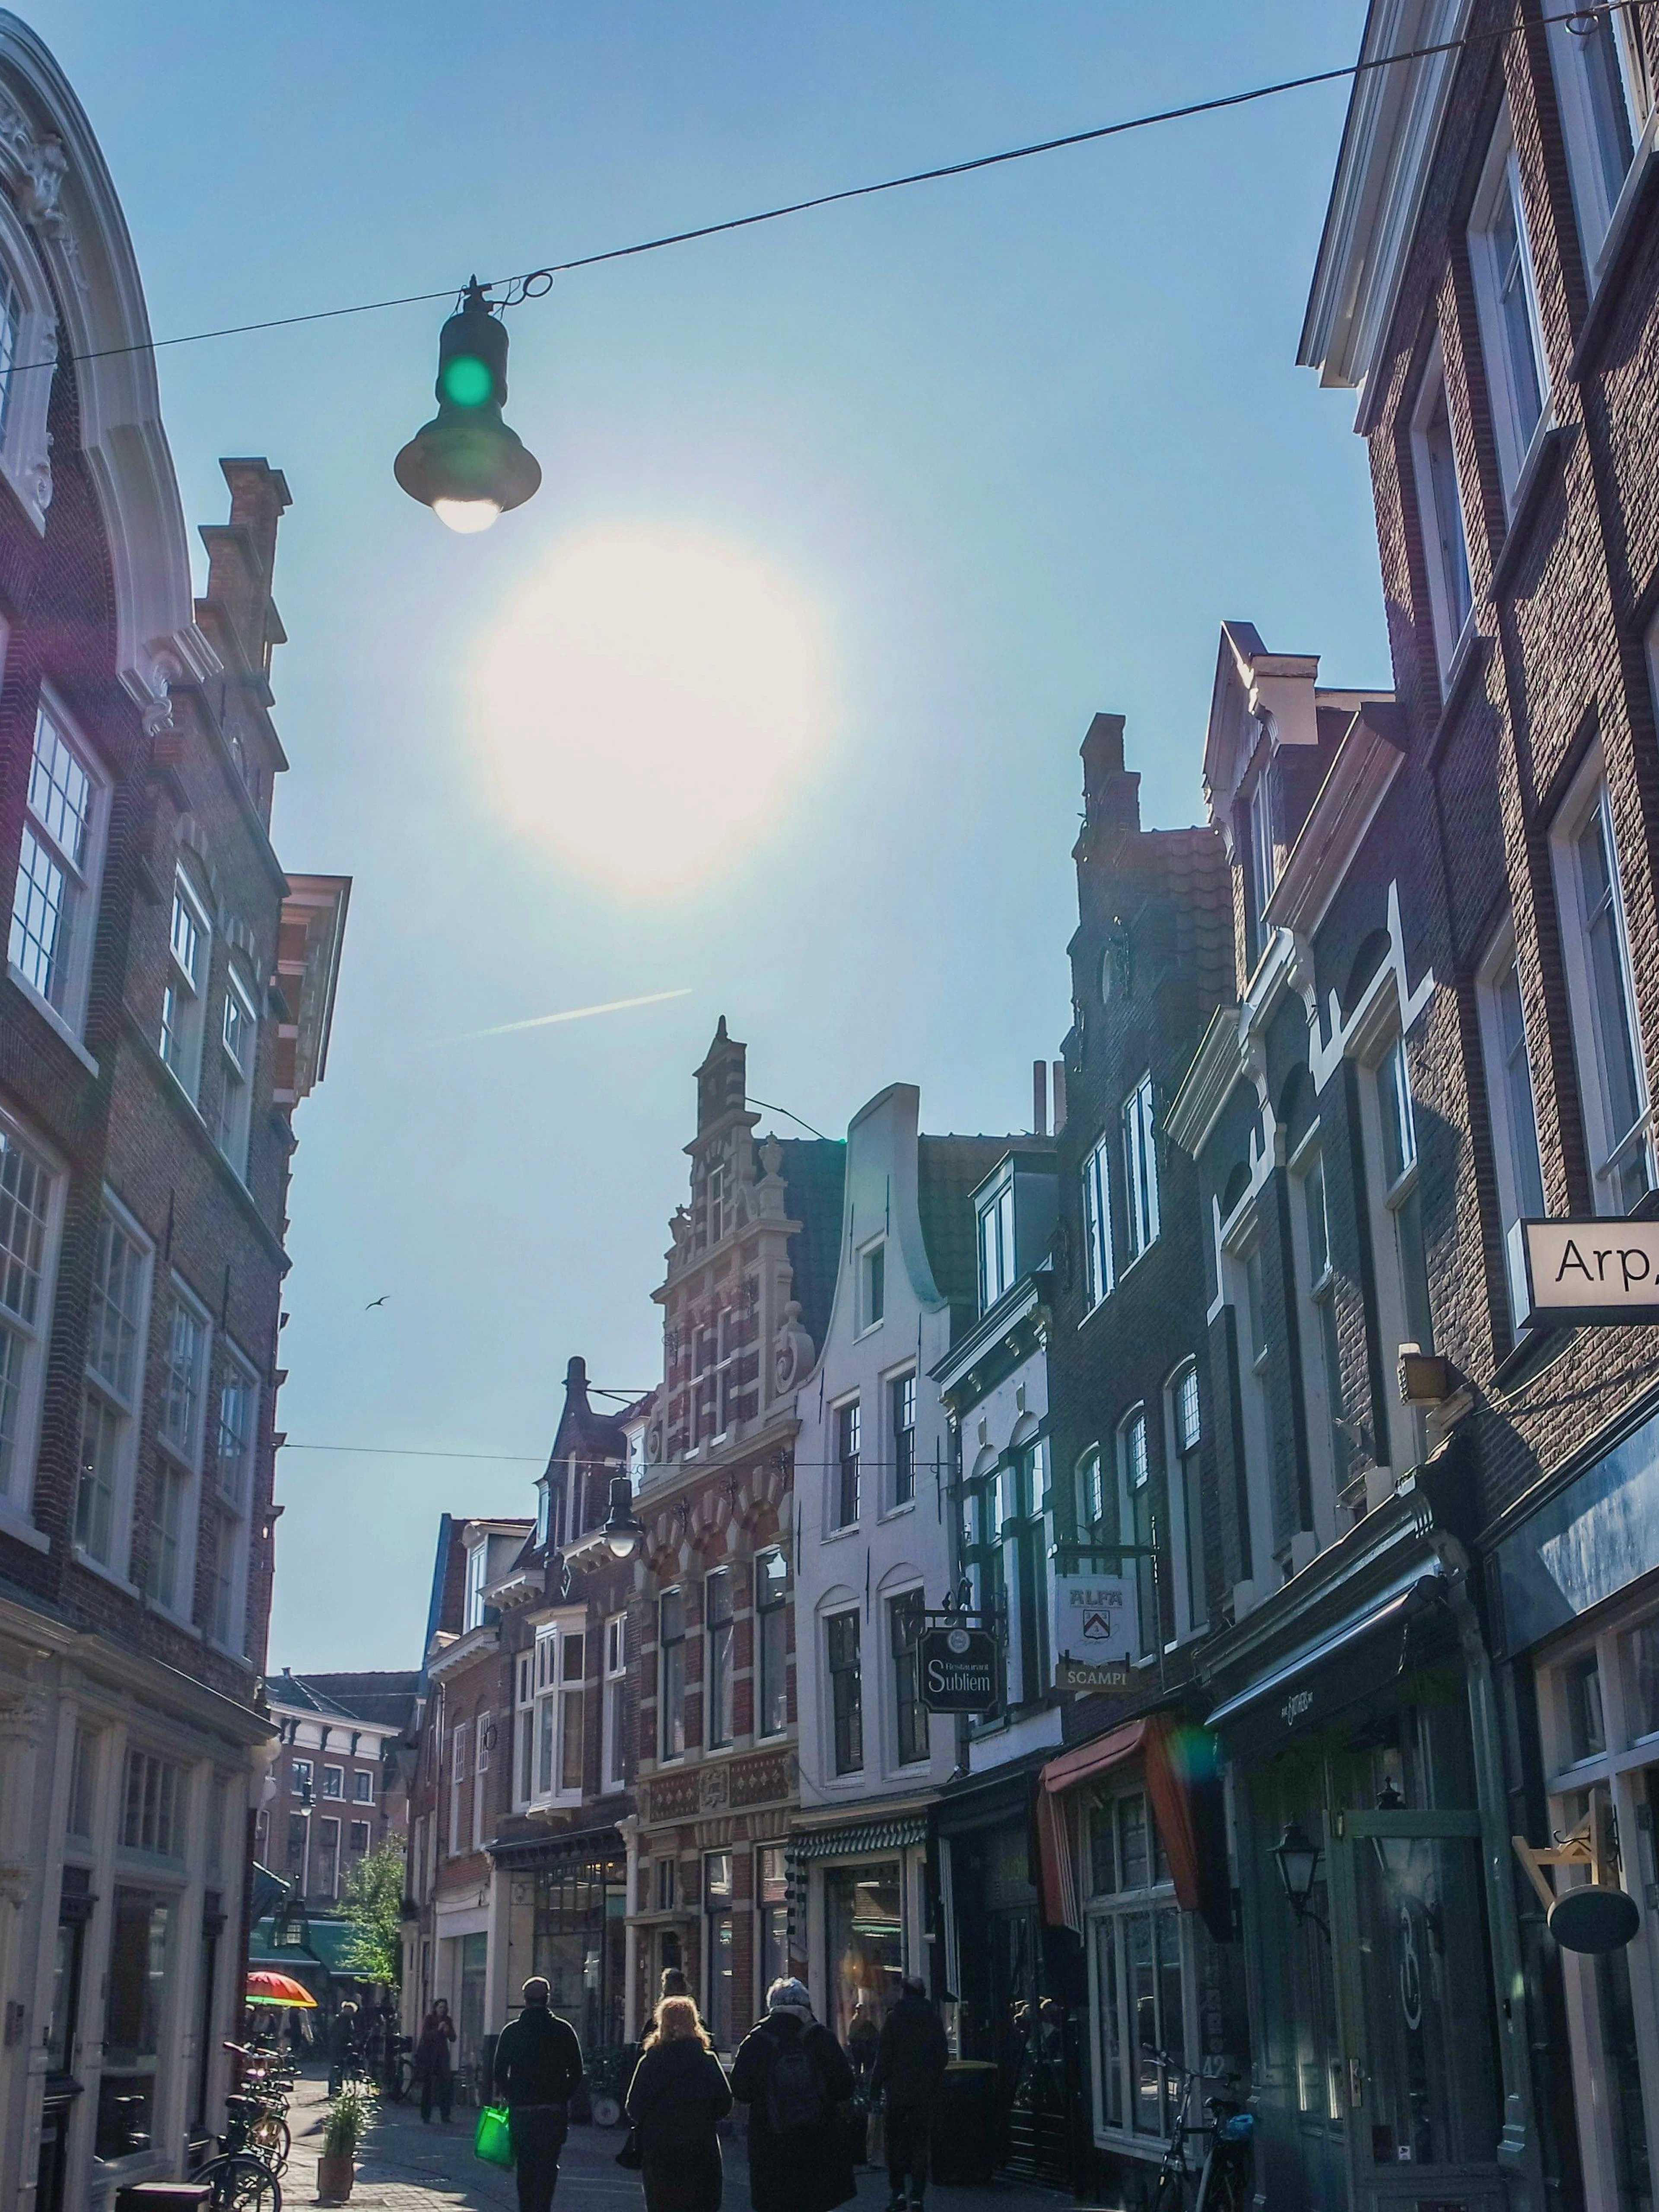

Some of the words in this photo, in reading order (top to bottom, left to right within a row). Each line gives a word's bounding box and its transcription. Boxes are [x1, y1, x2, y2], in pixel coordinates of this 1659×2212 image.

[1070, 1589, 1122, 1605] ALFA
[928, 1659, 990, 1692] Subliem
[1068, 1671, 1126, 1685] SCAMPI
[1202, 2055, 1224, 2077] 42
